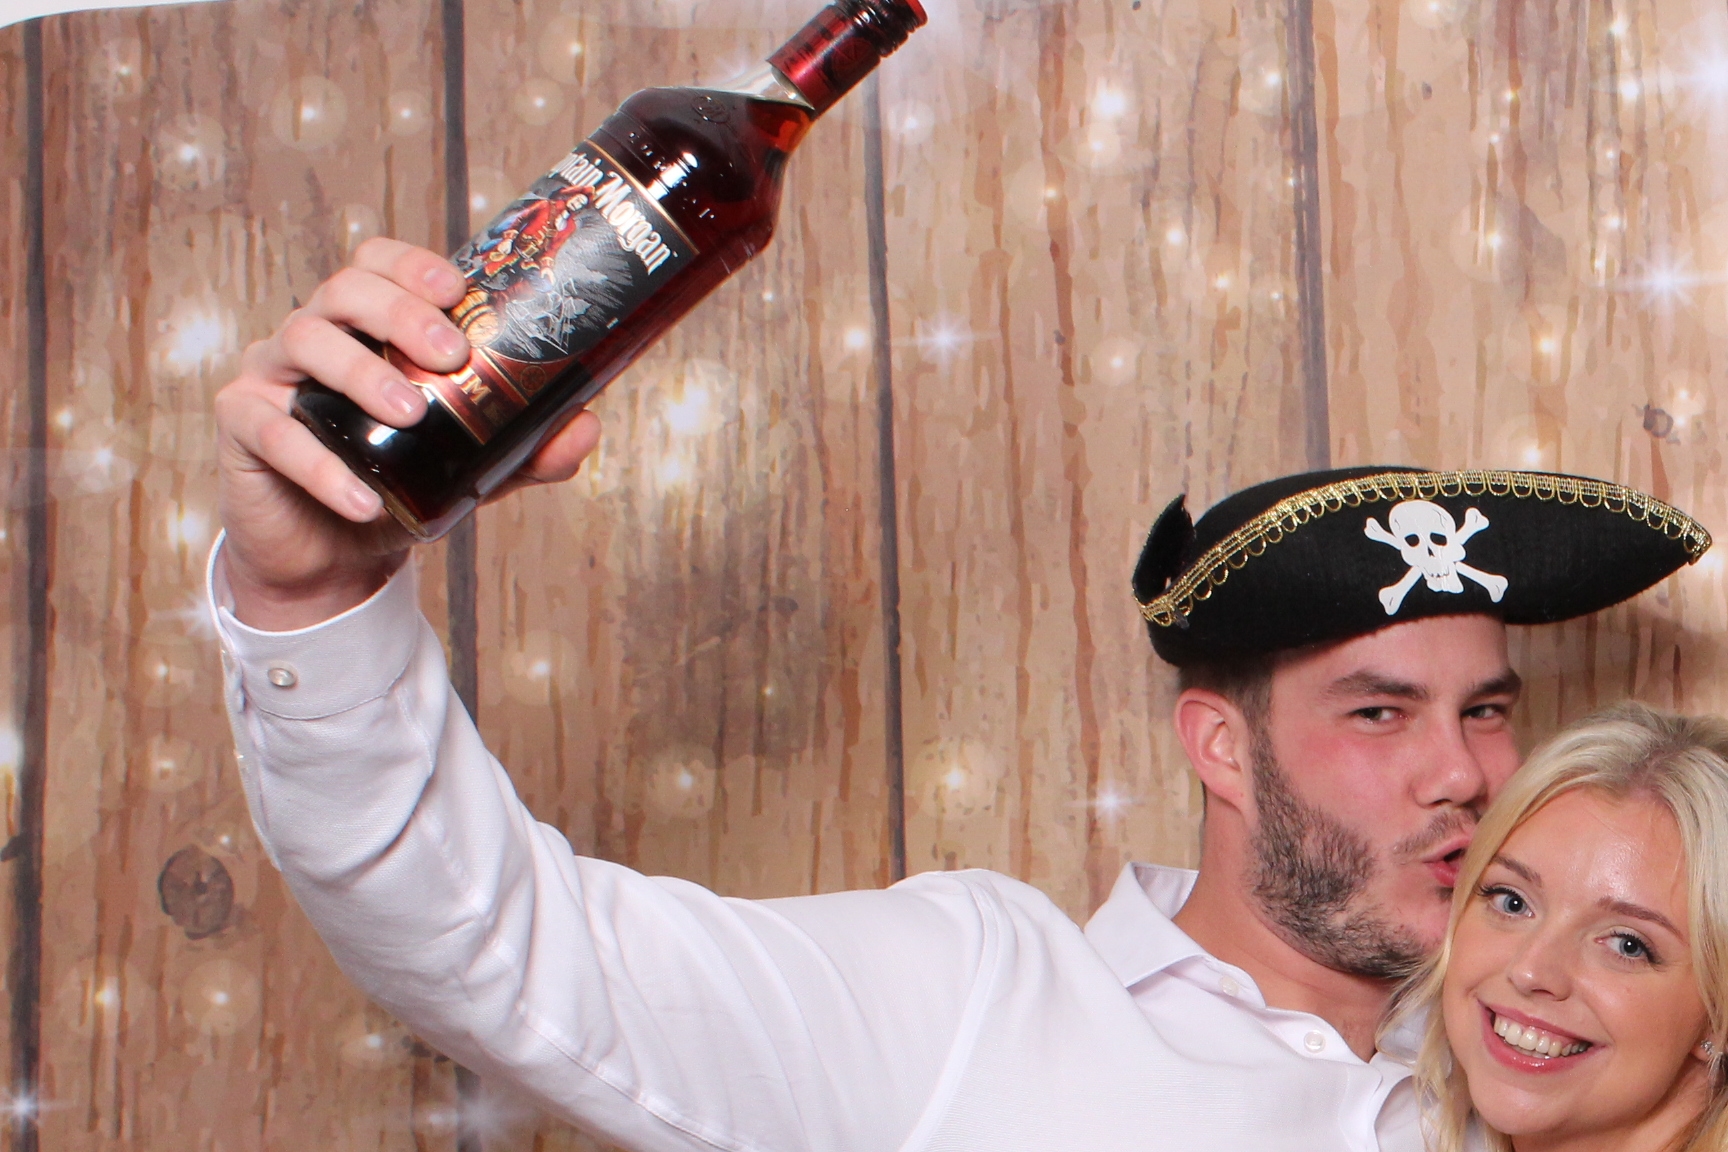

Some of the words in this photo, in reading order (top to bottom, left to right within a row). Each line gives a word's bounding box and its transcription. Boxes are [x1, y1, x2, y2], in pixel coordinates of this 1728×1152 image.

[548, 152, 604, 187] ptain
[595, 171, 672, 276] Morgan
[449, 366, 493, 406] UM
